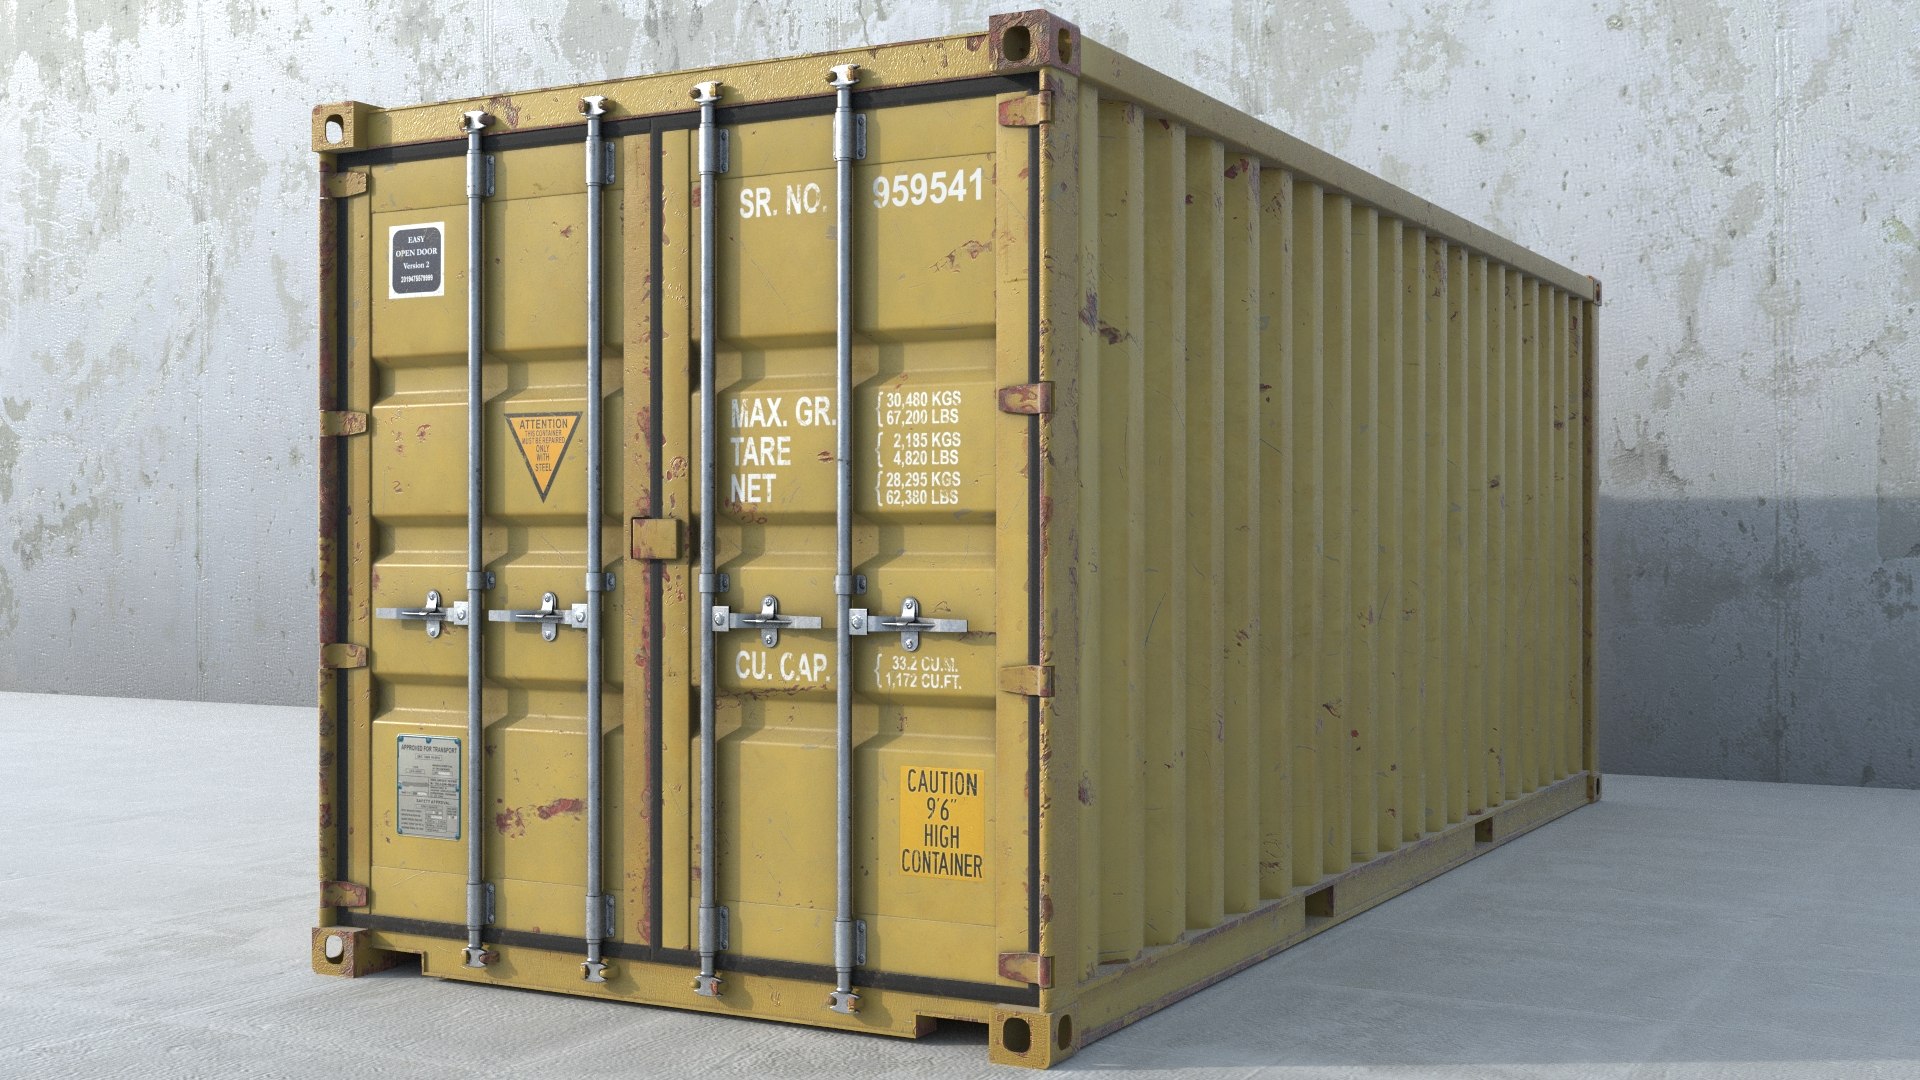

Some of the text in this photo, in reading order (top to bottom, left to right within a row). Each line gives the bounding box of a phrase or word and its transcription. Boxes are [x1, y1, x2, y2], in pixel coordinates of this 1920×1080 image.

[739, 167, 983, 219] SR. NO. 959541
[408, 235, 425, 244] EASY
[396, 248, 438, 258] OPEN DOOR
[403, 262, 424, 270] Version
[886, 390, 962, 409] 30,480 KGS
[731, 396, 837, 428] MAX. GR.
[886, 408, 959, 427] 67,200 LBS
[520, 418, 568, 430] ATTENTION
[536, 444, 550, 453] ONLY
[542, 436, 566, 444] REPAIRED
[893, 432, 962, 450] 2,185 KGS
[536, 453, 550, 462] WITH
[730, 436, 791, 466] TARE
[893, 450, 959, 467] 4,820 LBS
[535, 463, 552, 472] STEEL
[730, 473, 777, 503] NET
[886, 471, 962, 489] 28,295 KGS
[886, 489, 959, 507] 62,380 LBS
[735, 650, 831, 682] CU. CAP.
[892, 656, 918, 671] 33.2
[886, 672, 962, 690] 1,172 CU.FT.
[401, 744, 423, 752] APPROVED
[432, 746, 457, 754] TRANSPORT
[907, 768, 978, 796] CAUTION
[924, 824, 960, 849] HIGH
[902, 848, 983, 879] CONTAINER
